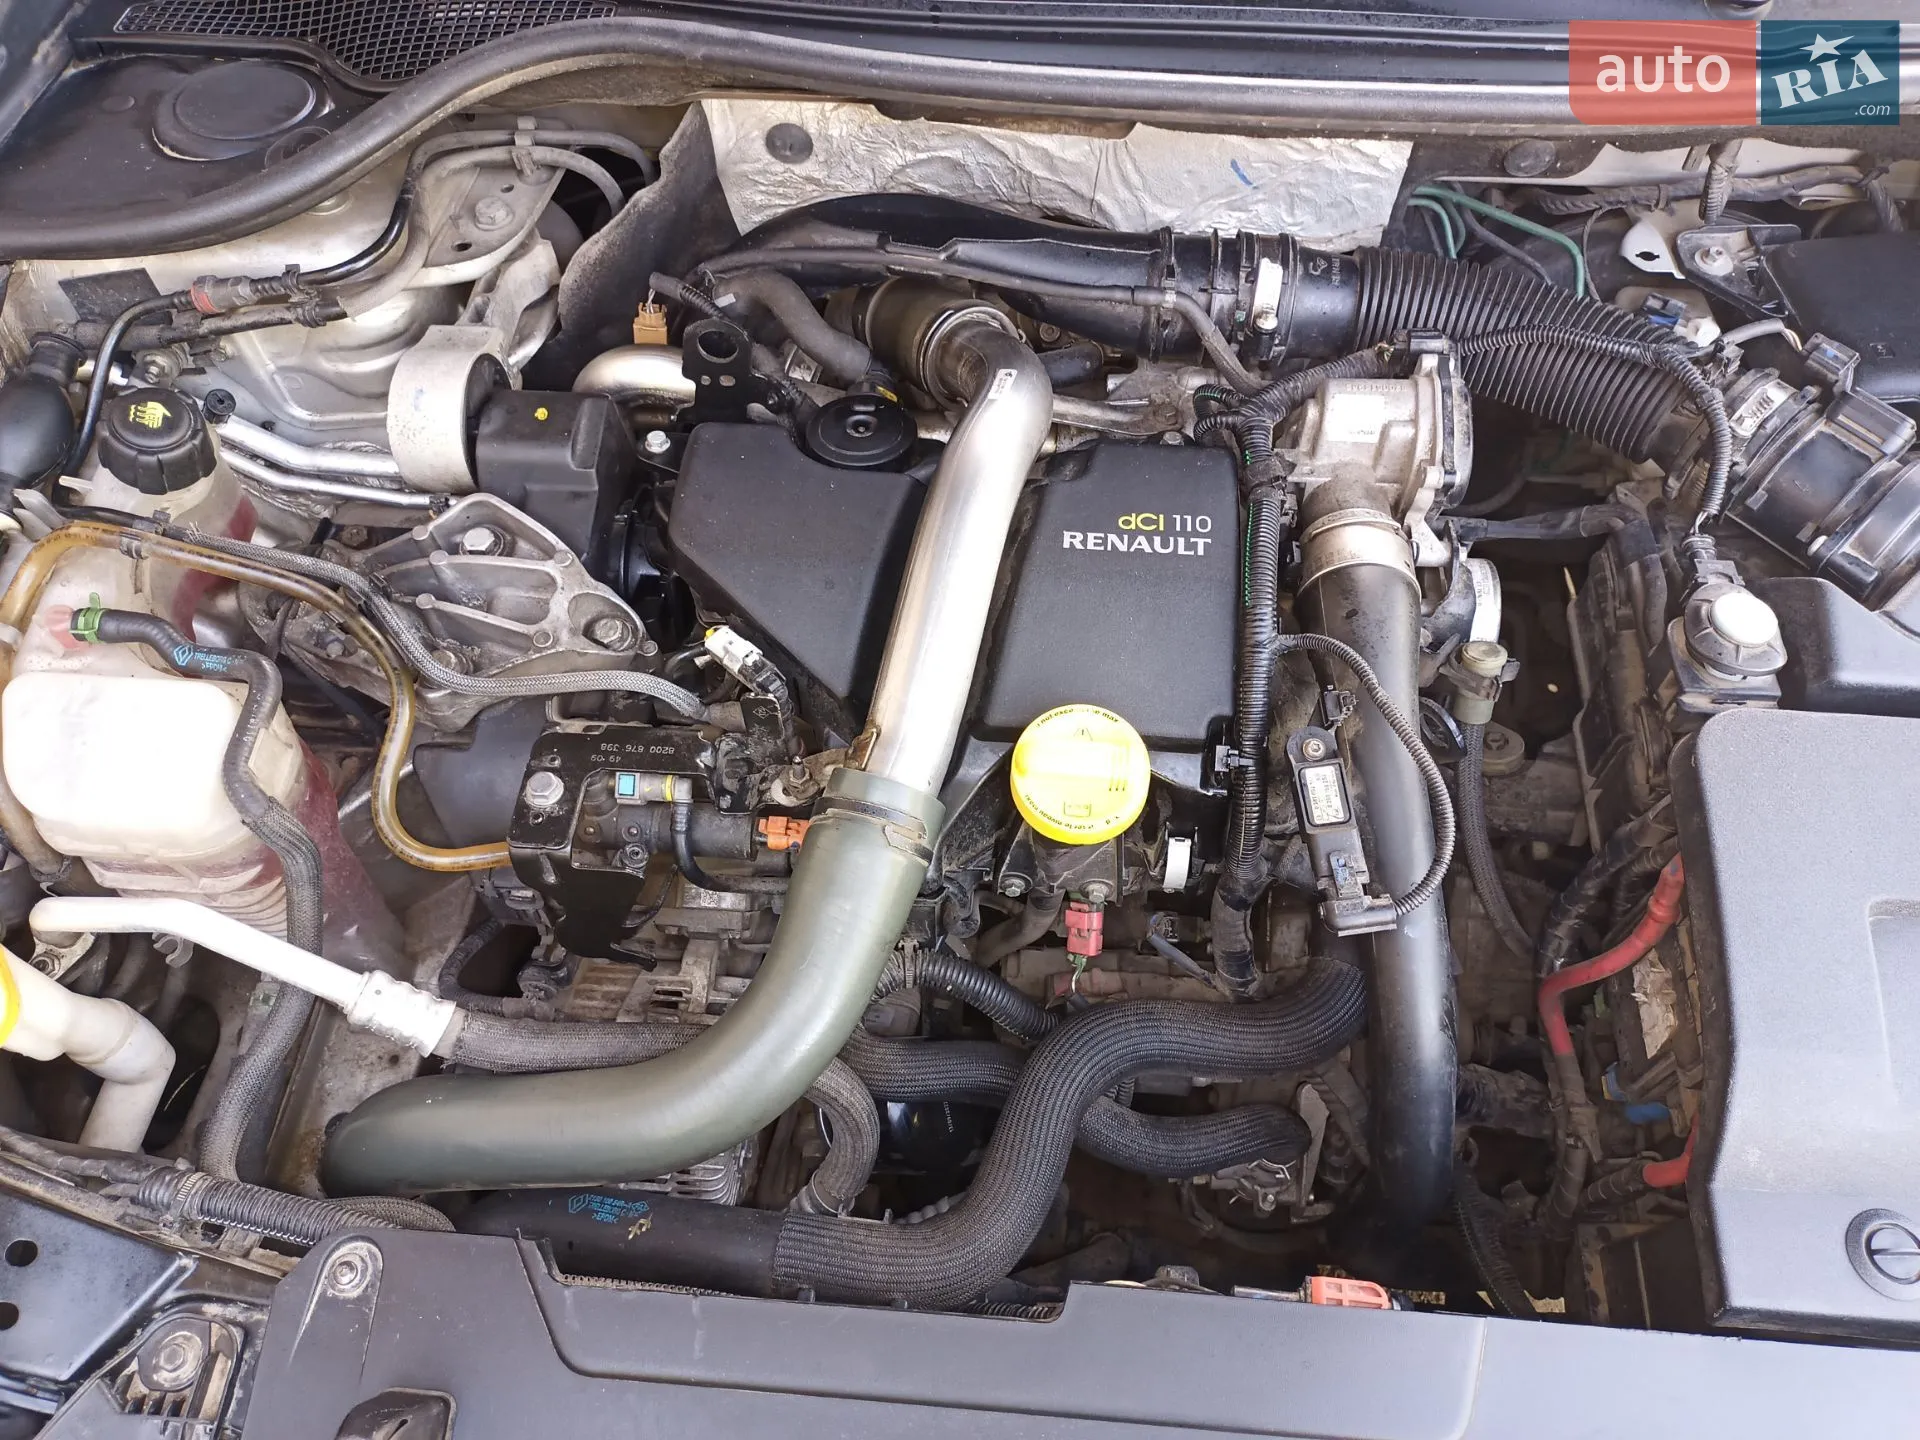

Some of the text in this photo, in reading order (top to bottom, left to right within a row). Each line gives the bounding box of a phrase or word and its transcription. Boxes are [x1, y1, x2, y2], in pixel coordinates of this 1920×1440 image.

[1172, 514, 1212, 533] 110
[1062, 530, 1212, 556] RENAULT
[600, 743, 675, 755] 8200 876 398
[608, 755, 622, 763] 49
